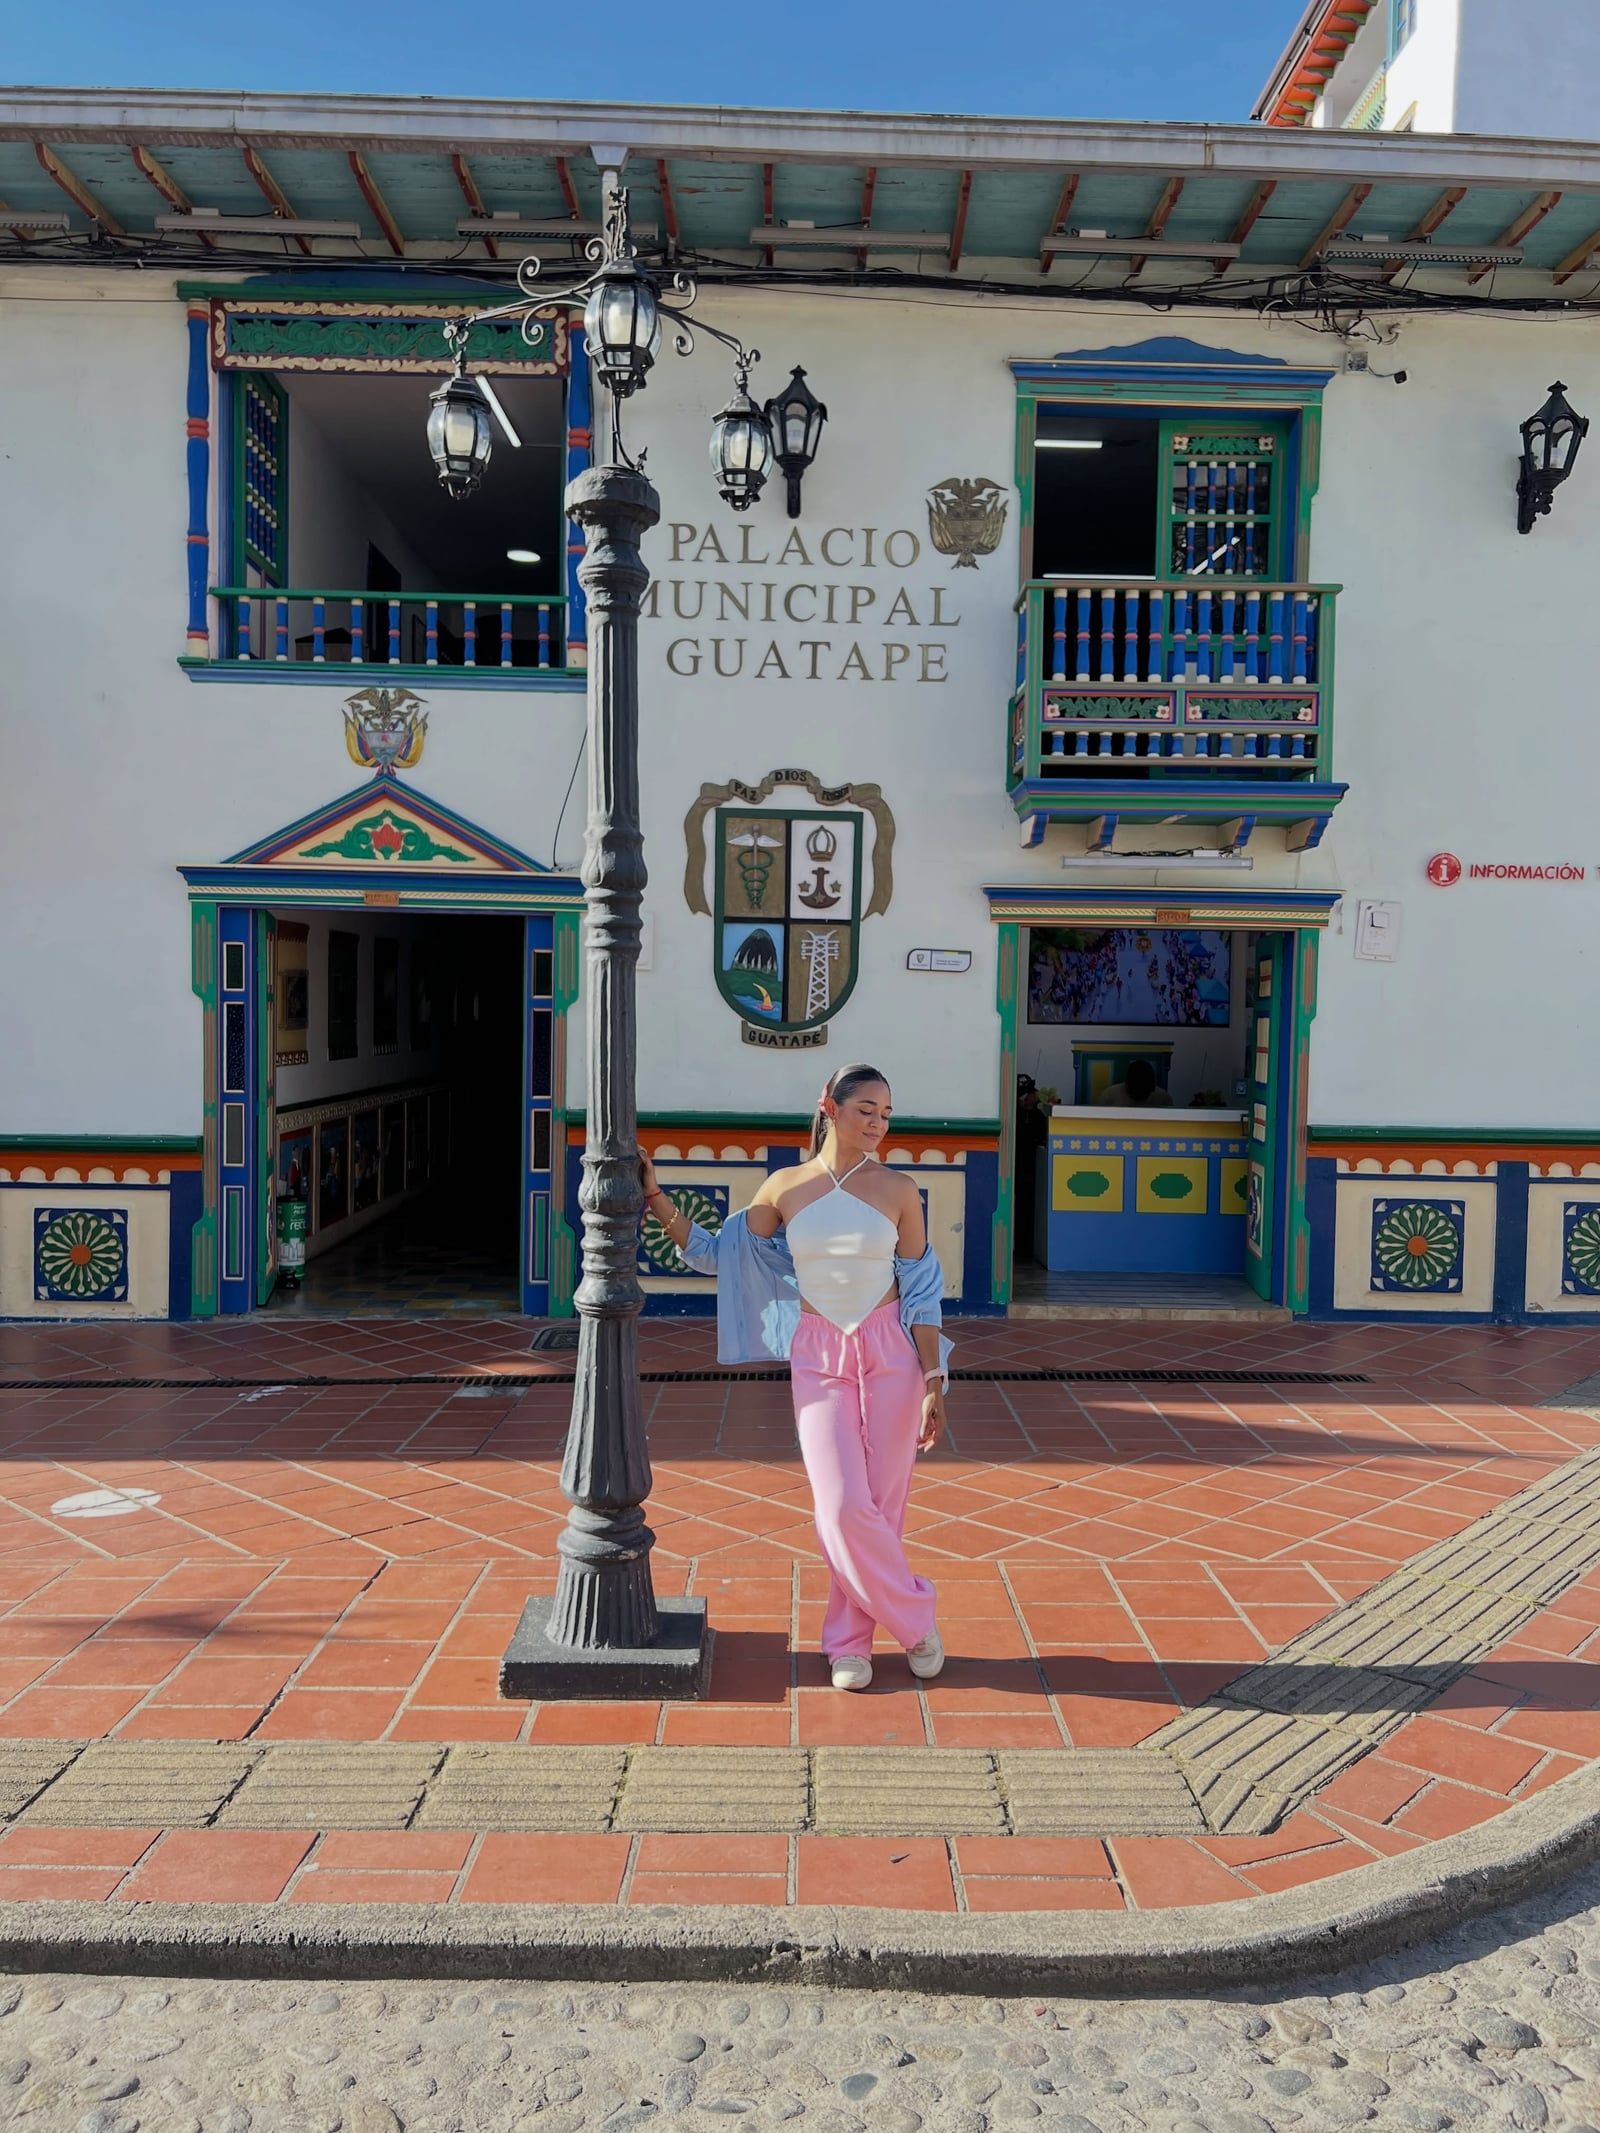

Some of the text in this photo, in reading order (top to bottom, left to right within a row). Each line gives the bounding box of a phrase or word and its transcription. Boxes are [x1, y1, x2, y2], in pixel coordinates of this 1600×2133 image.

[668, 523, 921, 568] PALACIO
[666, 638, 950, 683] GUATAPE
[734, 770, 808, 801] PAZ DIOS
[1469, 862, 1585, 881] INFORMACIÓN
[748, 1030, 822, 1047] GUATAPÉ
